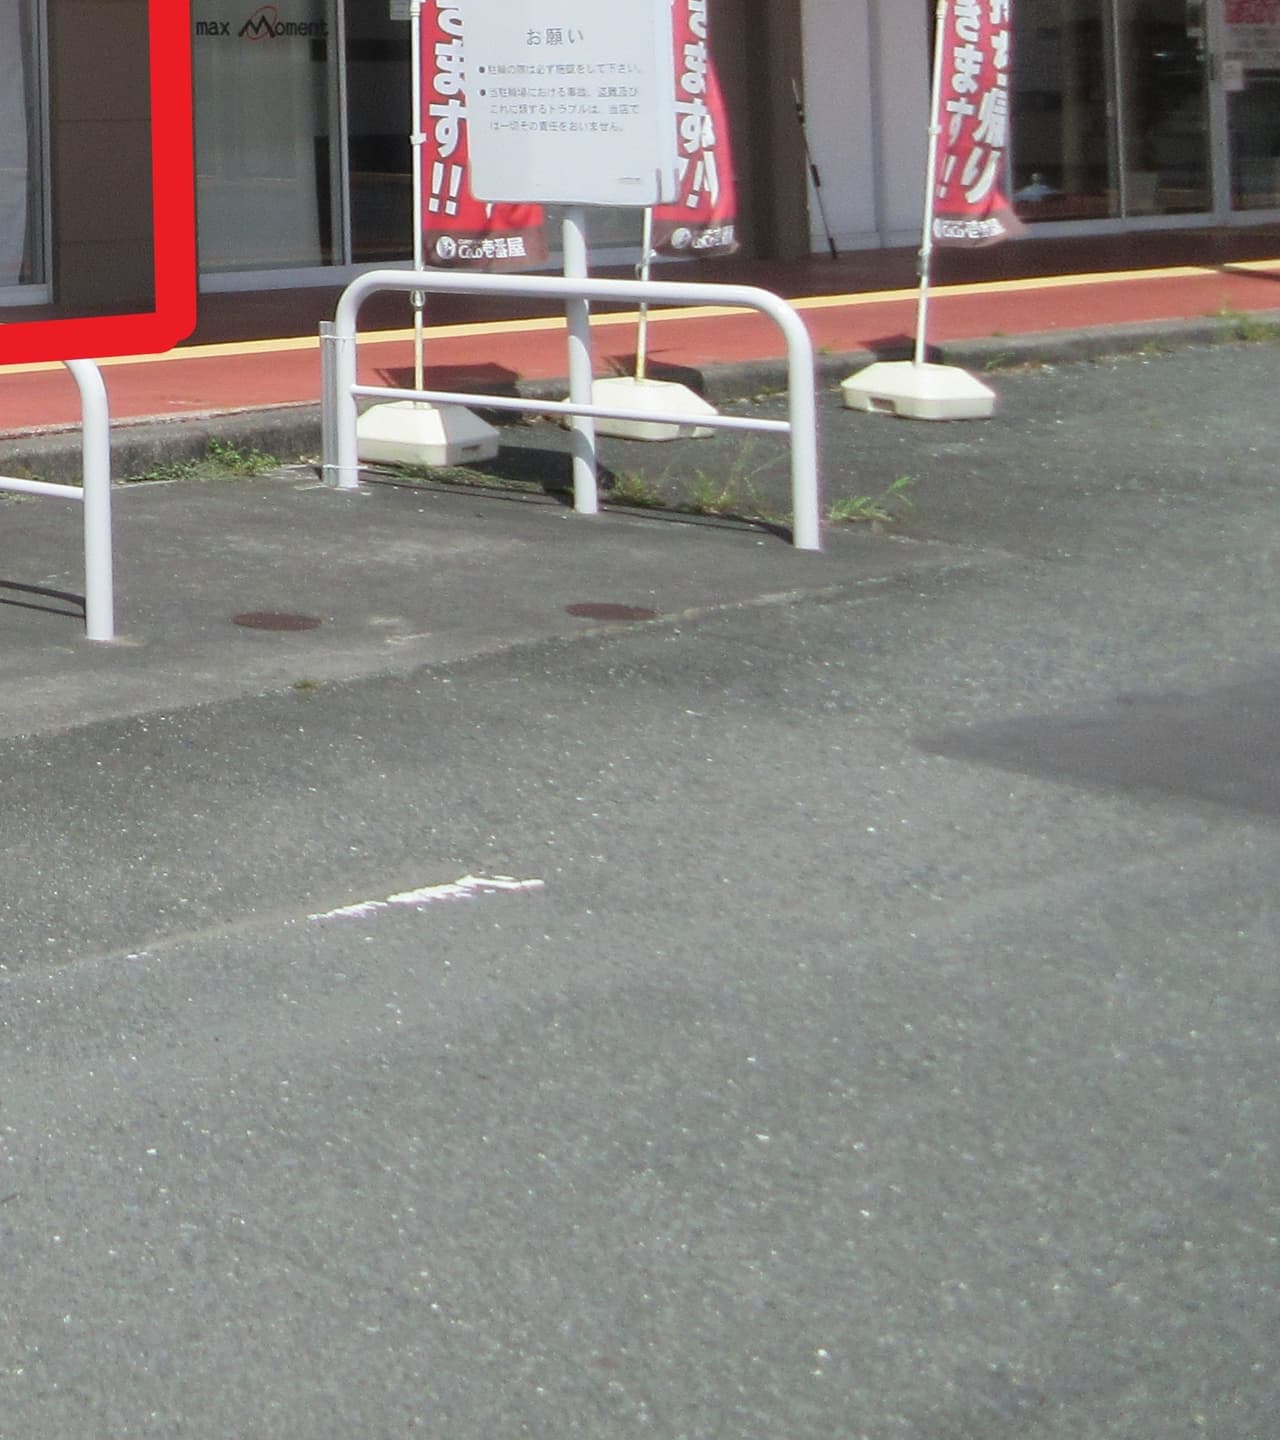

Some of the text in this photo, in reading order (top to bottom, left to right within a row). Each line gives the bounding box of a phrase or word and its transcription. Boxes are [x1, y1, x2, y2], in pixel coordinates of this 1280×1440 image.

[195, 14, 329, 39] max Moment
[526, 28, 585, 46] お願い
